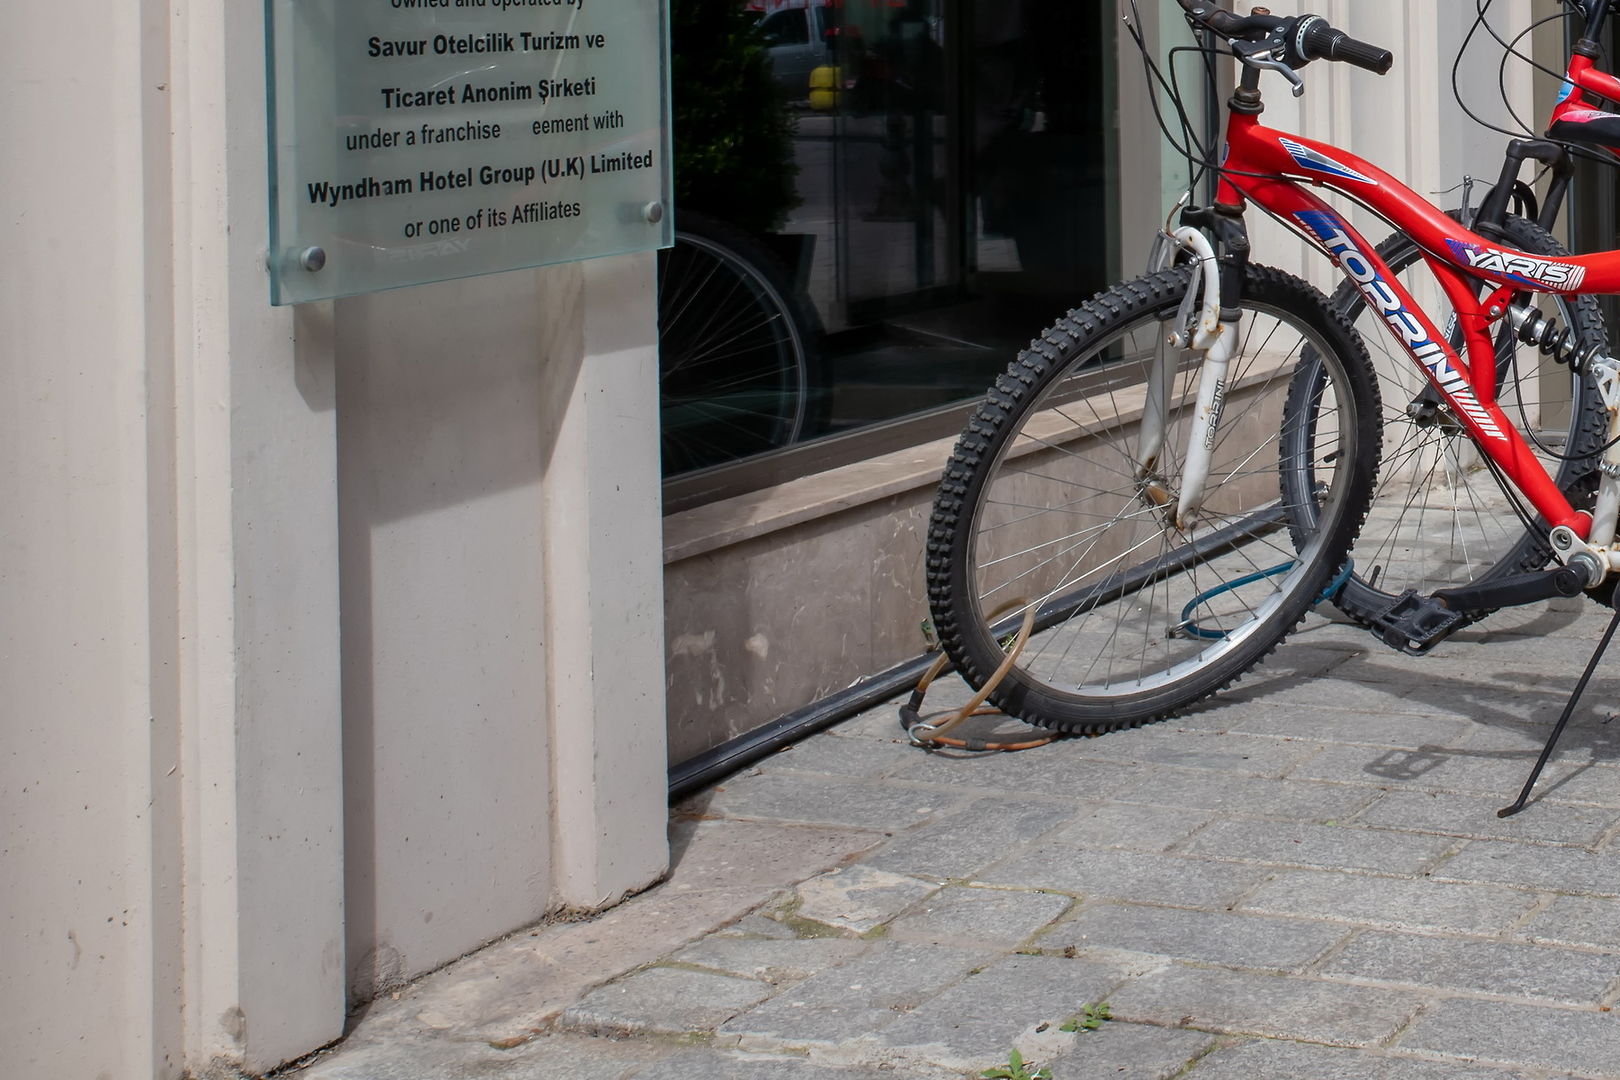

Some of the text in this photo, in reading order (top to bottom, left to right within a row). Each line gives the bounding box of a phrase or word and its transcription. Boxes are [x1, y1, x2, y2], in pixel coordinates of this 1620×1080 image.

[368, 31, 606, 57] Savur Otelcilik Turizm ve
[381, 76, 597, 109] Ticaret Anonim Şirketi
[346, 128, 401, 151] under
[405, 128, 416, 146] a
[421, 120, 501, 144] franchise
[593, 110, 625, 131] with
[307, 149, 653, 208] Wyndham Hotel Group (U.K) Limited
[404, 199, 581, 239] or one of its Affiliates
[1464, 248, 1571, 283] YARIS
[1324, 228, 1471, 394] TORRINI
[1204, 379, 1226, 450] TORRINI
